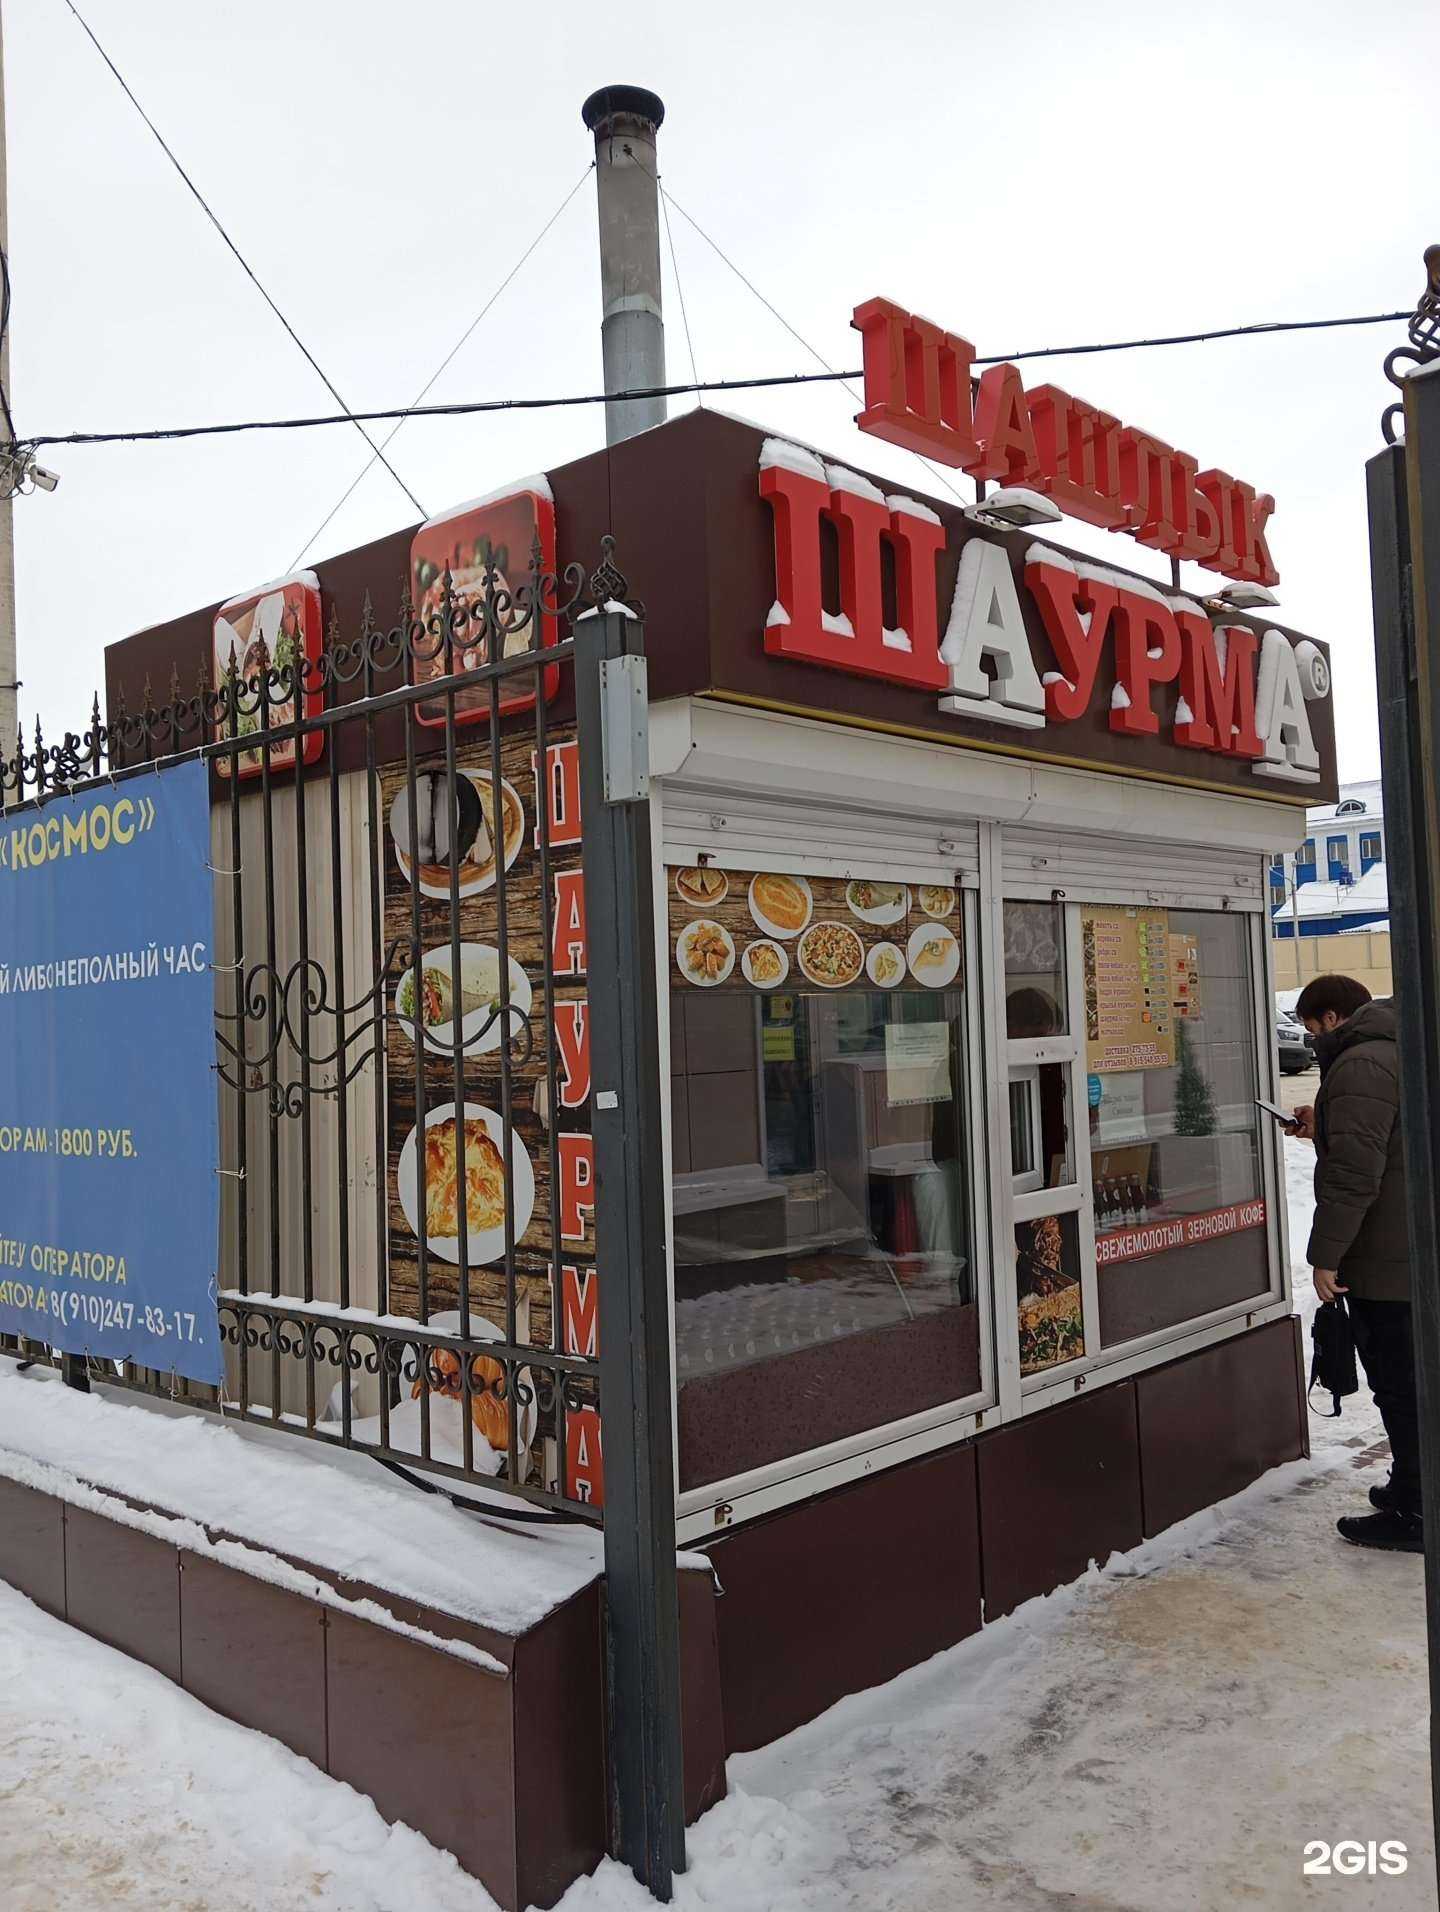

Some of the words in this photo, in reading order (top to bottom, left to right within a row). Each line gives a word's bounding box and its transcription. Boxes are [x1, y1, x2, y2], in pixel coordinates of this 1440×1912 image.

[851, 297, 1280, 587] ШАШЛЫК
[163, 942, 206, 975] ЧАС
[98, 1130, 138, 1157] РУБ.
[1095, 1221, 1184, 1262] СВЕЖЕМОЛОТЫЙ
[1188, 1207, 1237, 1240] ЗЕРНОВОЙ
[1240, 1203, 1265, 1225] КОФЕ
